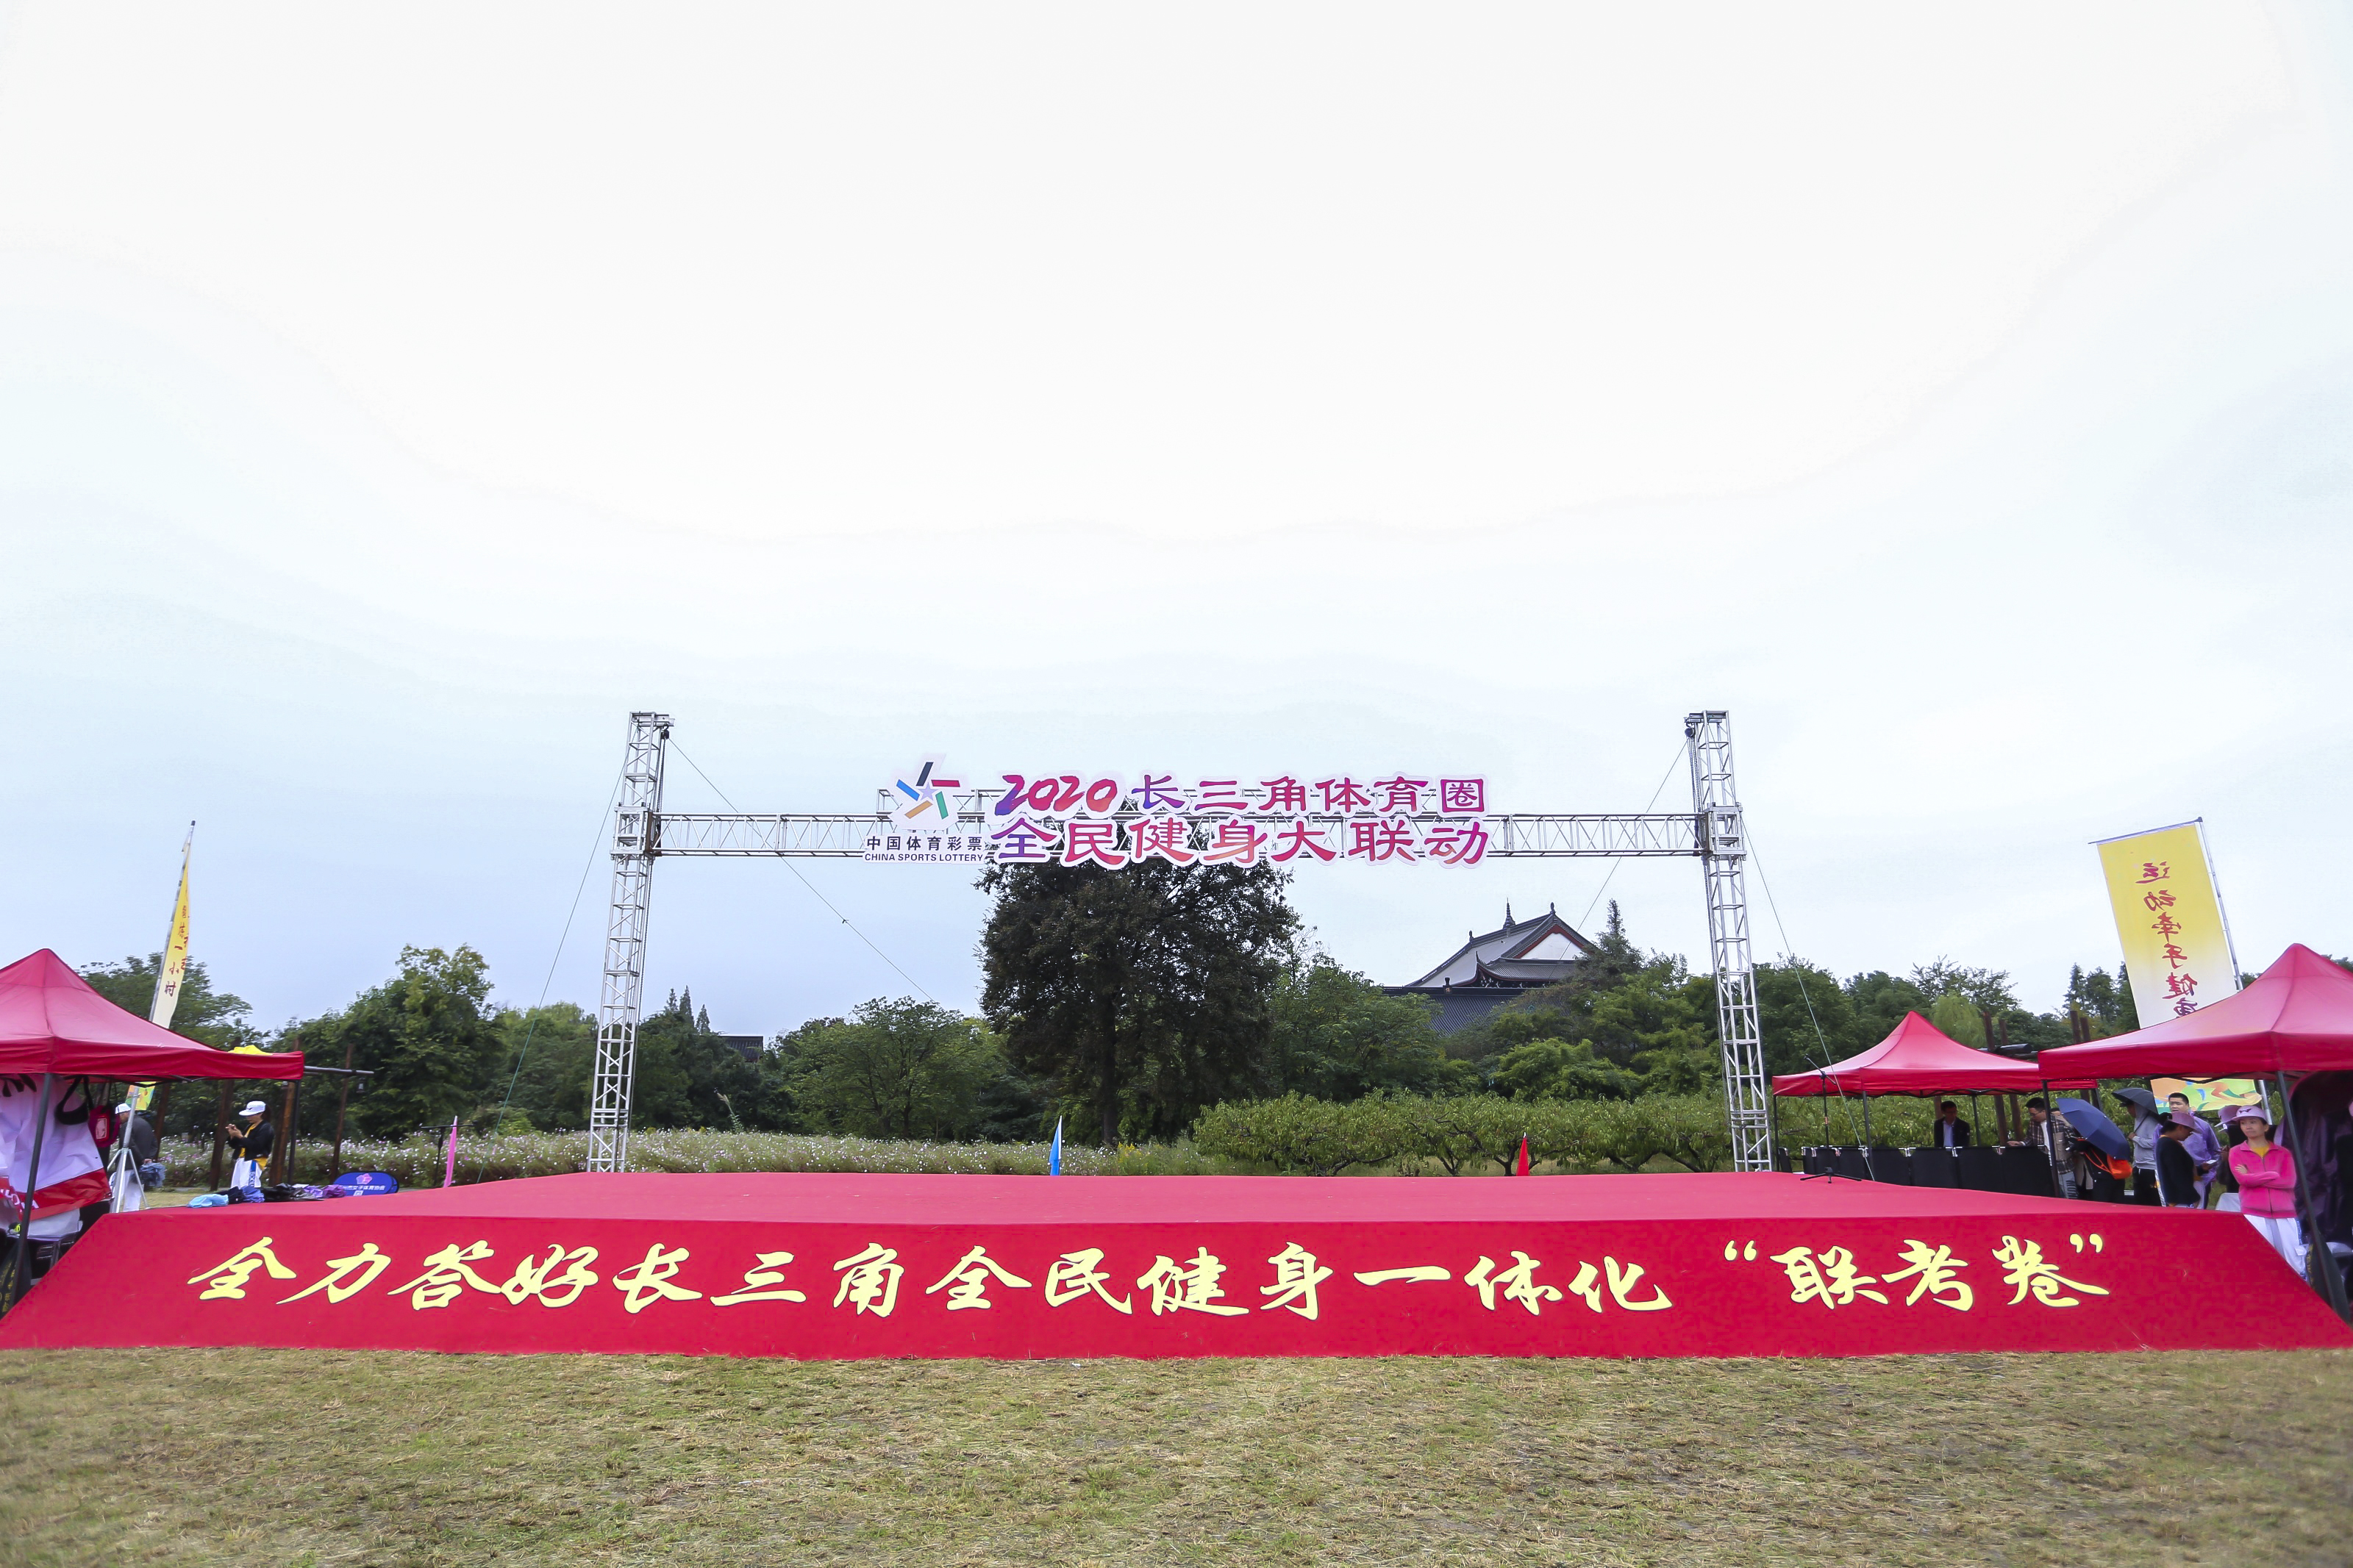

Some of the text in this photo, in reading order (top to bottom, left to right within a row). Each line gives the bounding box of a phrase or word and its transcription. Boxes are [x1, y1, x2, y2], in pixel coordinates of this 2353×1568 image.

[866, 835, 982, 851] 中国体育彩票
[990, 817, 1489, 865] 全民健身大联动
[864, 853, 984, 862] CHINA SPORTS LOTTERY
